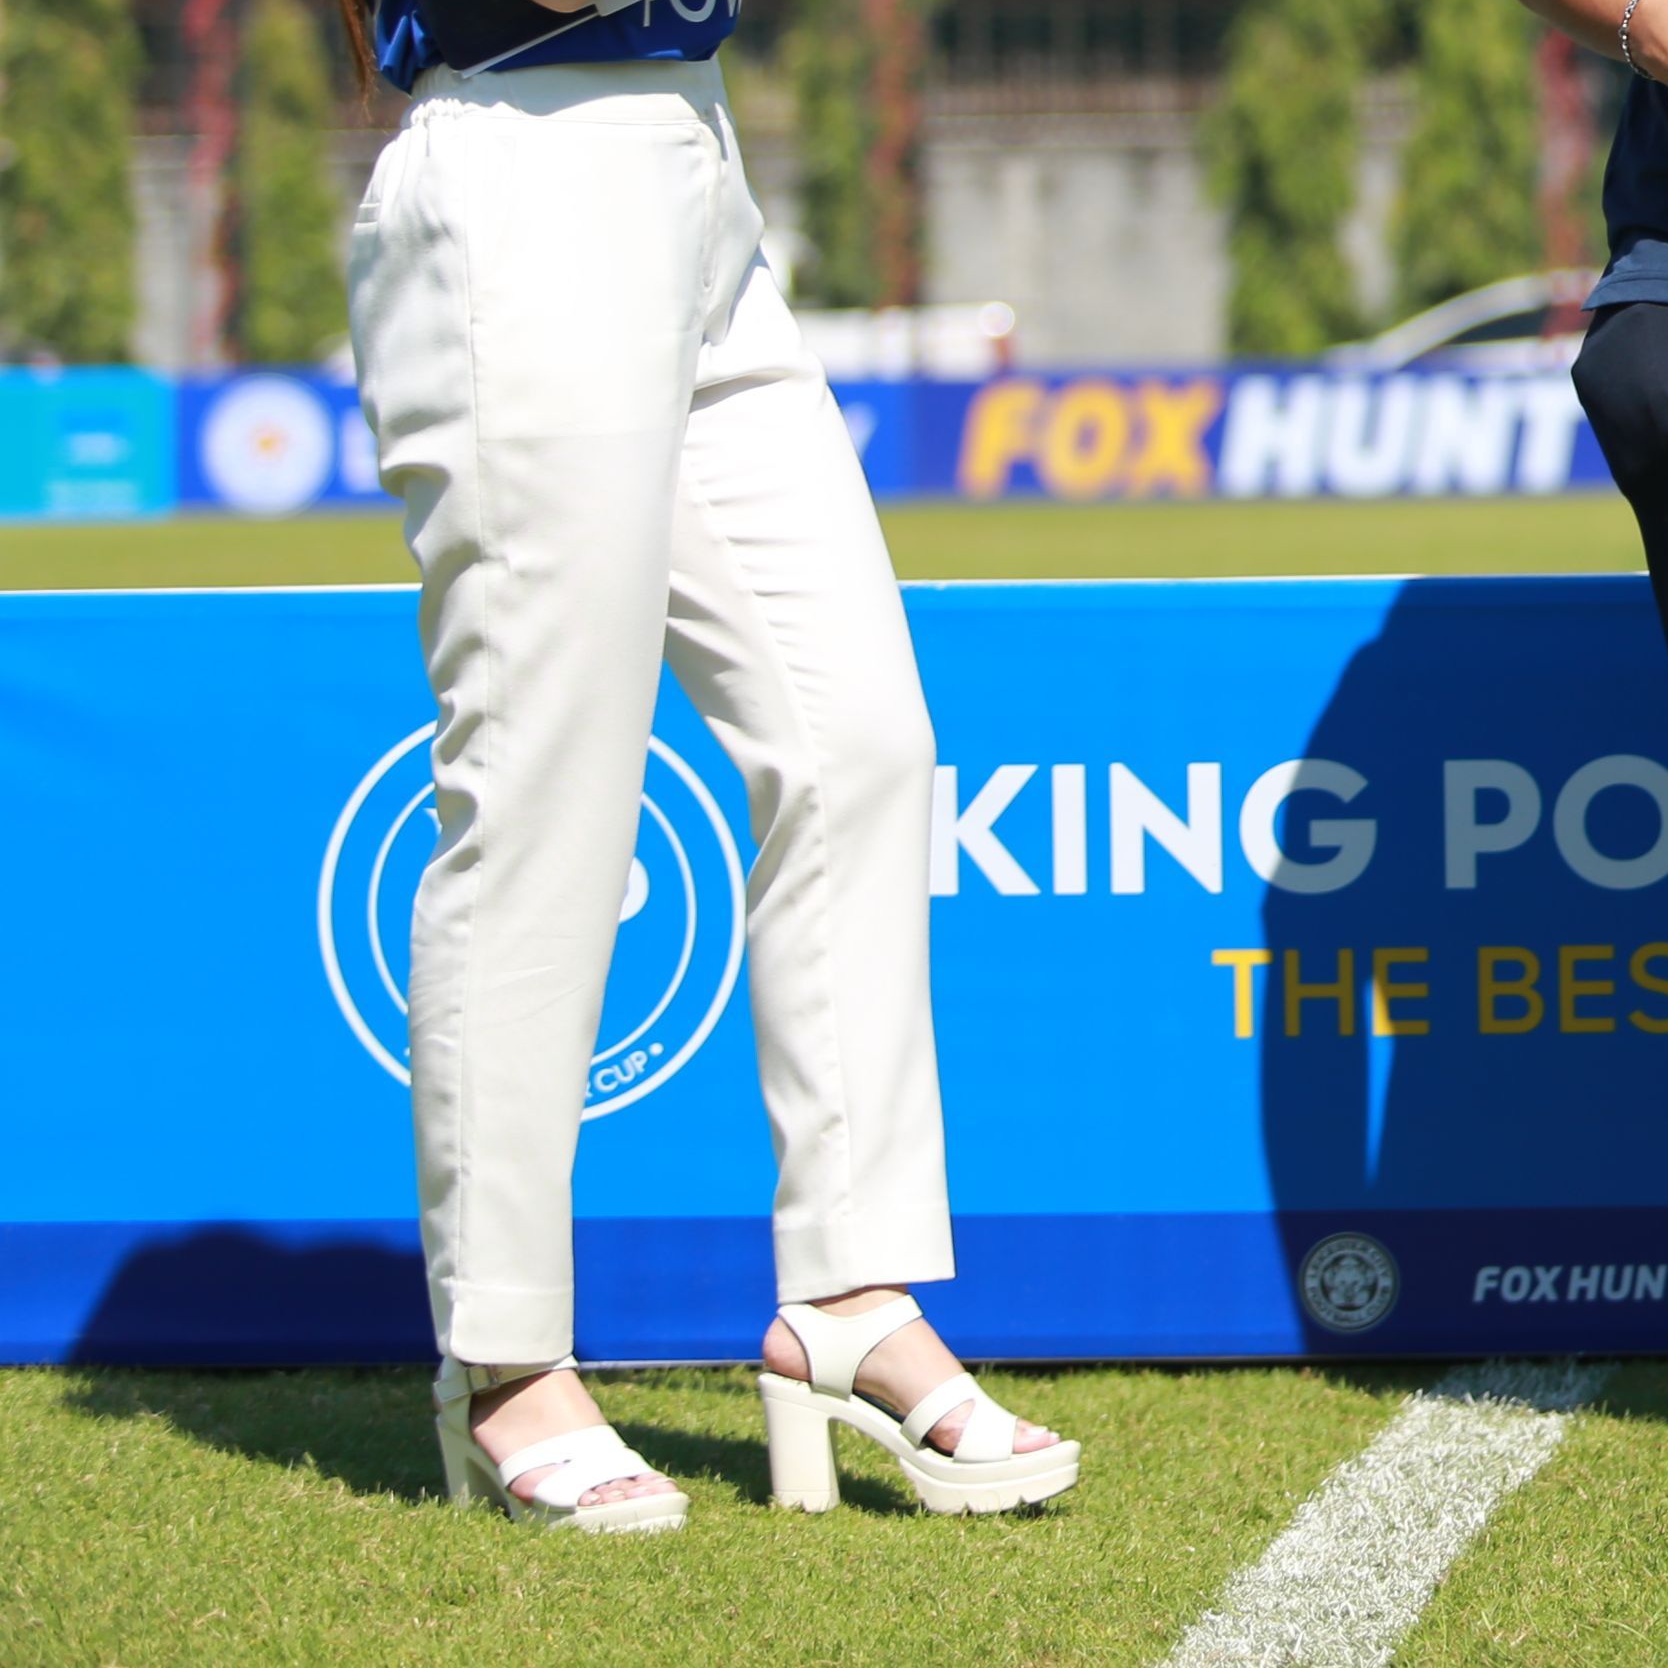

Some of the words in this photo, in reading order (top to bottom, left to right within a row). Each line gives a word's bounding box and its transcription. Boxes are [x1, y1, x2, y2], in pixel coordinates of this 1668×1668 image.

[958, 376, 1224, 501] FOX
[1217, 372, 1582, 500] HUNT
[929, 759, 1378, 896] KING
[1211, 947, 1430, 1038] THE
[593, 1049, 648, 1094] CUP
[1472, 1264, 1564, 1303] FOX
